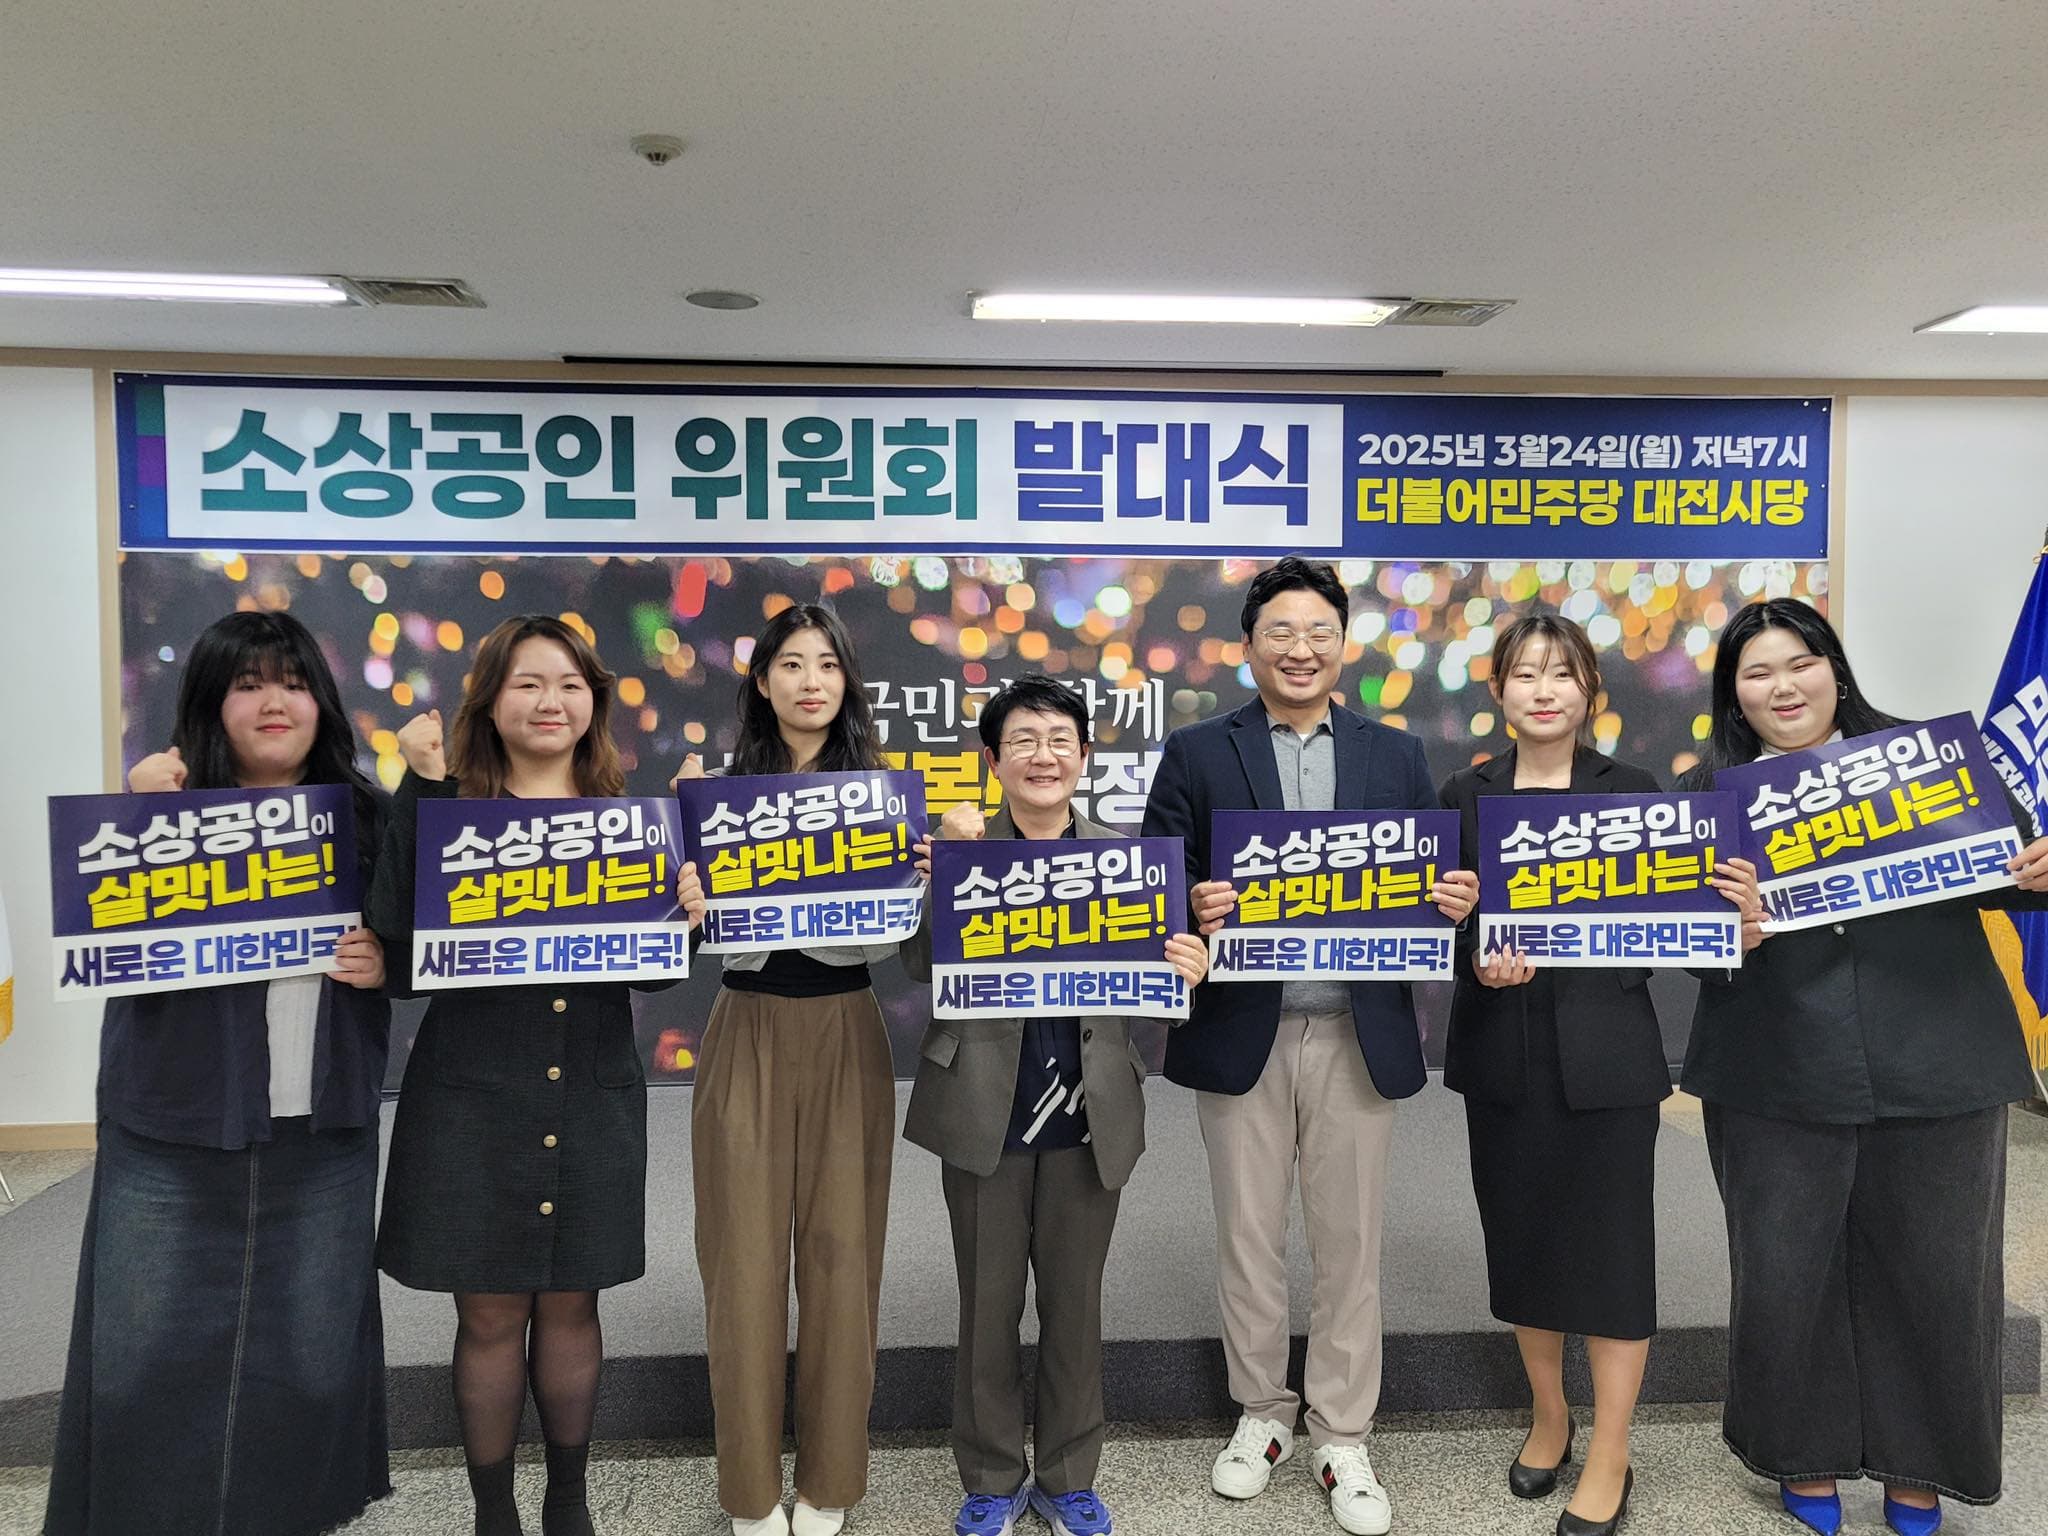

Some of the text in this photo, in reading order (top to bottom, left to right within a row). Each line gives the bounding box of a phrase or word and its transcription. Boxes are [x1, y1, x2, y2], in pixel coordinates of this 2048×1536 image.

[201, 408, 1310, 527] 소상공인 위원회 발대식
[1357, 434, 1807, 470] 2025년 3월24일(월) 저녁7시
[1356, 476, 1808, 527] 더불어민주당 대전시당
[700, 778, 907, 847] 소상공인이
[1747, 728, 1966, 832] 소상공인이
[78, 794, 335, 874] 소상공인이
[441, 805, 666, 873] 소상공인이
[1232, 817, 1438, 878] 소상공인이
[1500, 800, 1717, 864] 소상공인이
[1764, 767, 1980, 875] 살맛나는!
[87, 842, 337, 929] 살맛나는!
[447, 853, 667, 925] 살맛나는!
[708, 822, 908, 894] 살맛나는!
[953, 845, 1167, 911] 소상공인이
[1507, 846, 1716, 910] 살맛나는!
[960, 893, 1167, 959] 살맛나는!
[1237, 863, 1437, 924] 살맛나는!
[60, 924, 357, 988] 새로운 대한민국
[418, 932, 684, 978] 새로운 대한민국!
[1213, 936, 1450, 972] 새로운 대한민국!
[1484, 922, 1736, 958] 새로운 대한민국!
[937, 970, 1186, 1008] 새로운 대한민국!
